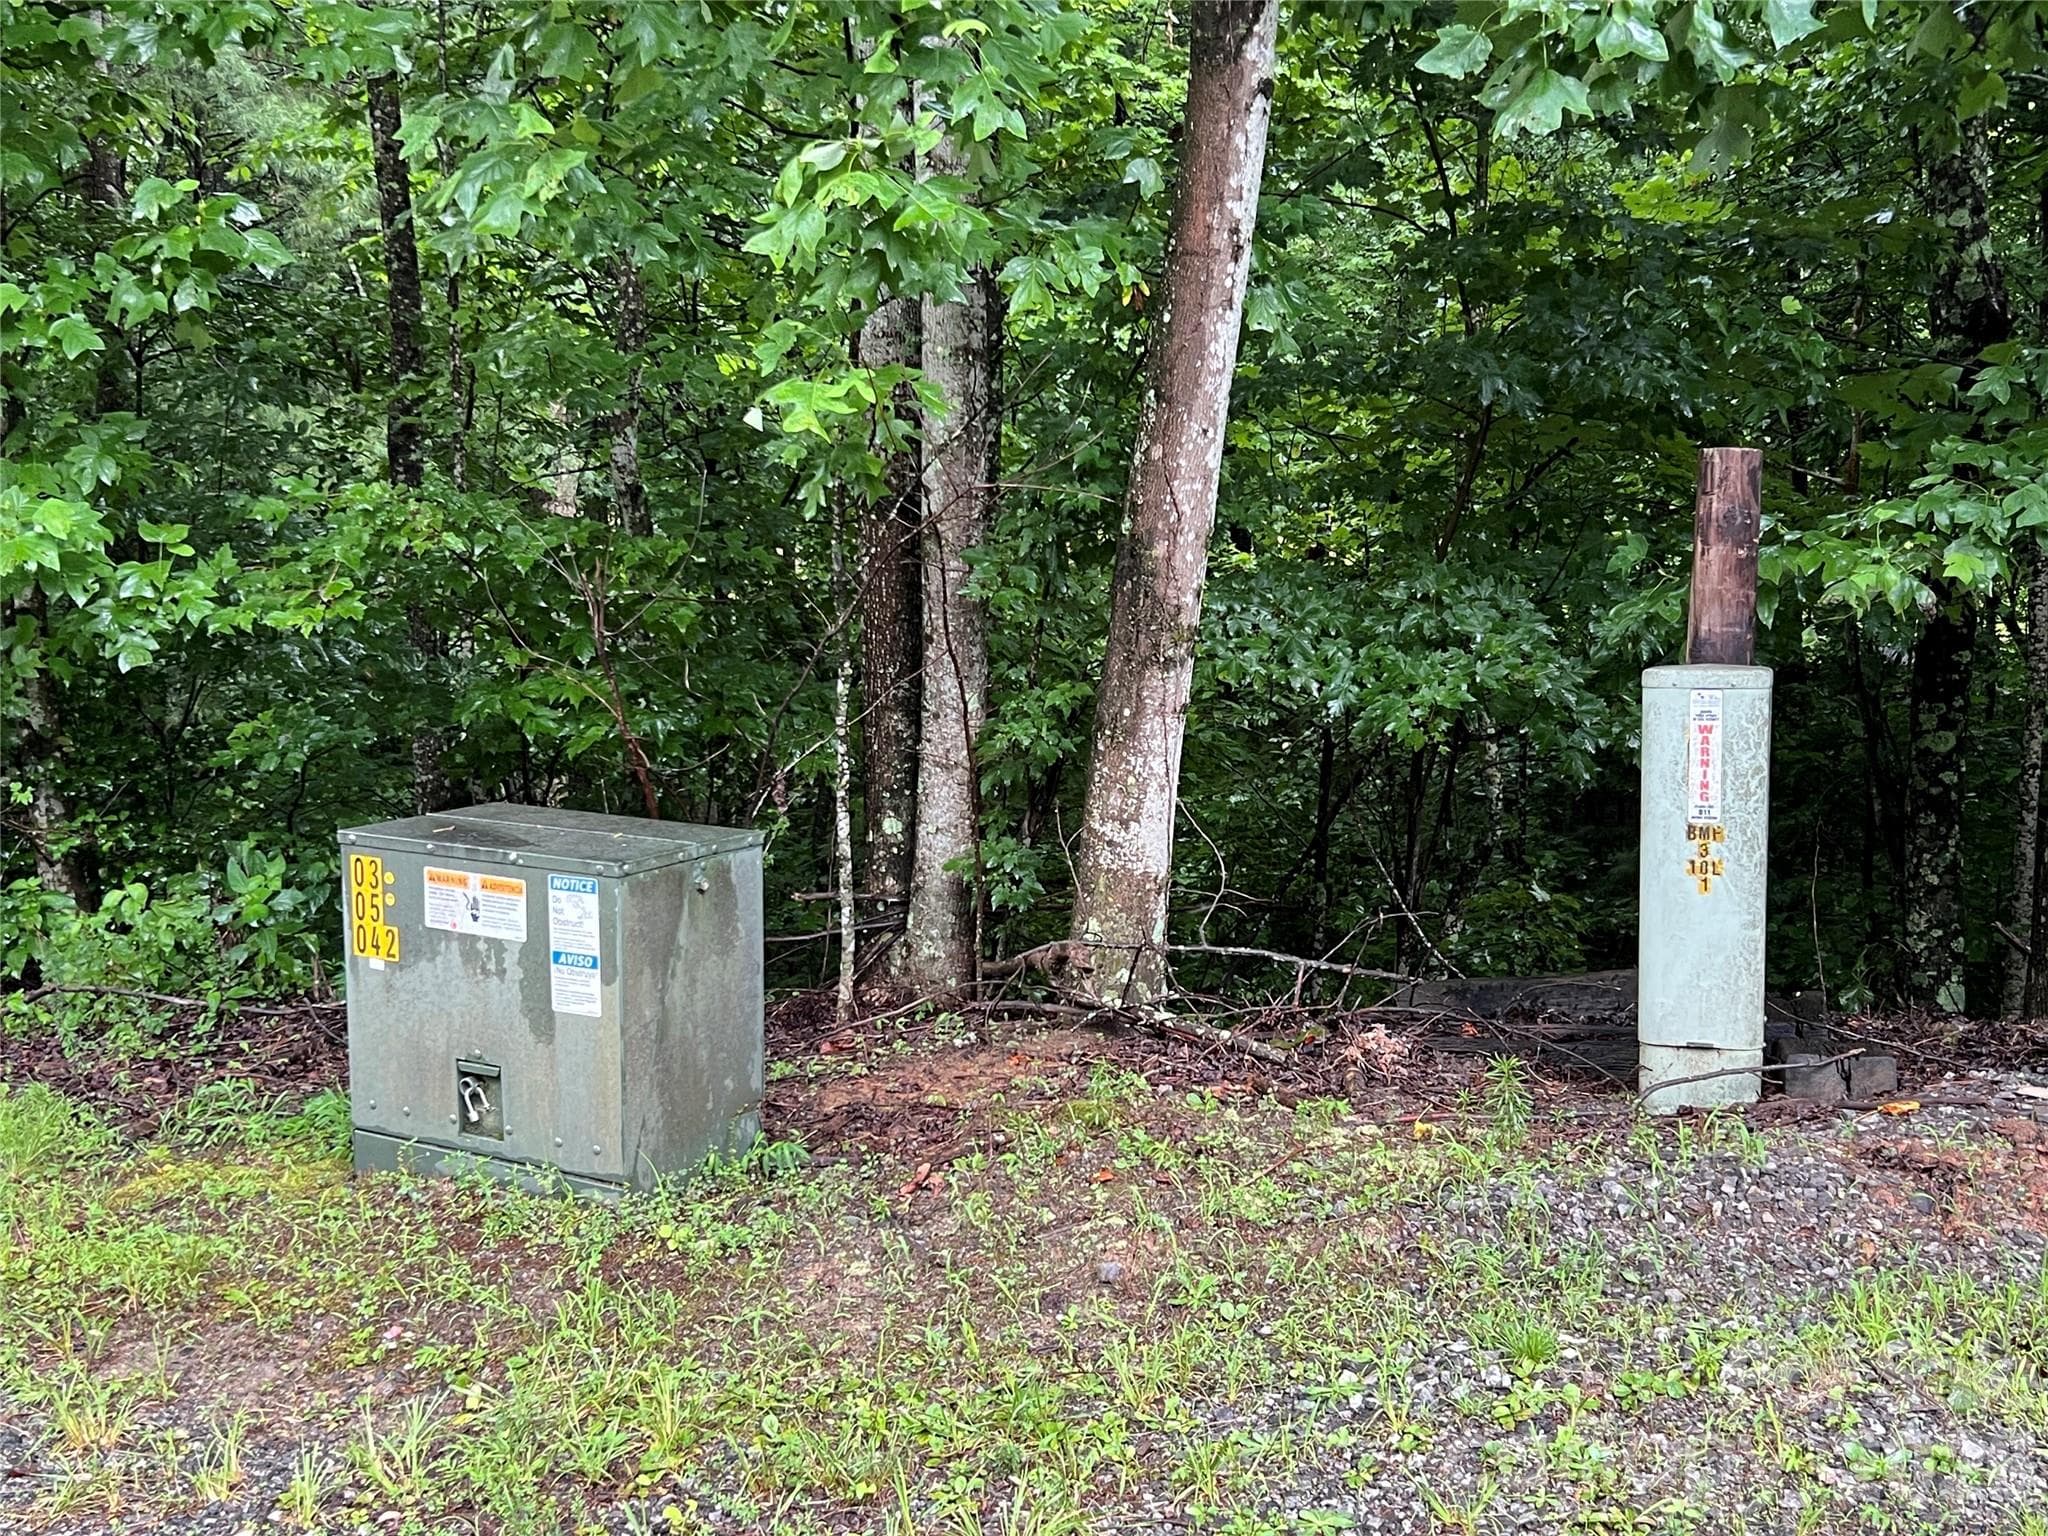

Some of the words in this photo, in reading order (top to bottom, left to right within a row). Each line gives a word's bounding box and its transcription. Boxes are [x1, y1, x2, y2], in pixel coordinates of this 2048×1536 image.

[1698, 724, 1713, 802] WARNING
[1700, 843, 1709, 858] 3
[354, 857, 379, 889] 03
[552, 878, 594, 893] NOTICE
[1700, 877, 1708, 892] 1
[355, 891, 380, 922] 05
[552, 894, 562, 904] Do
[357, 924, 396, 959] 042
[558, 952, 593, 968] AVISO
